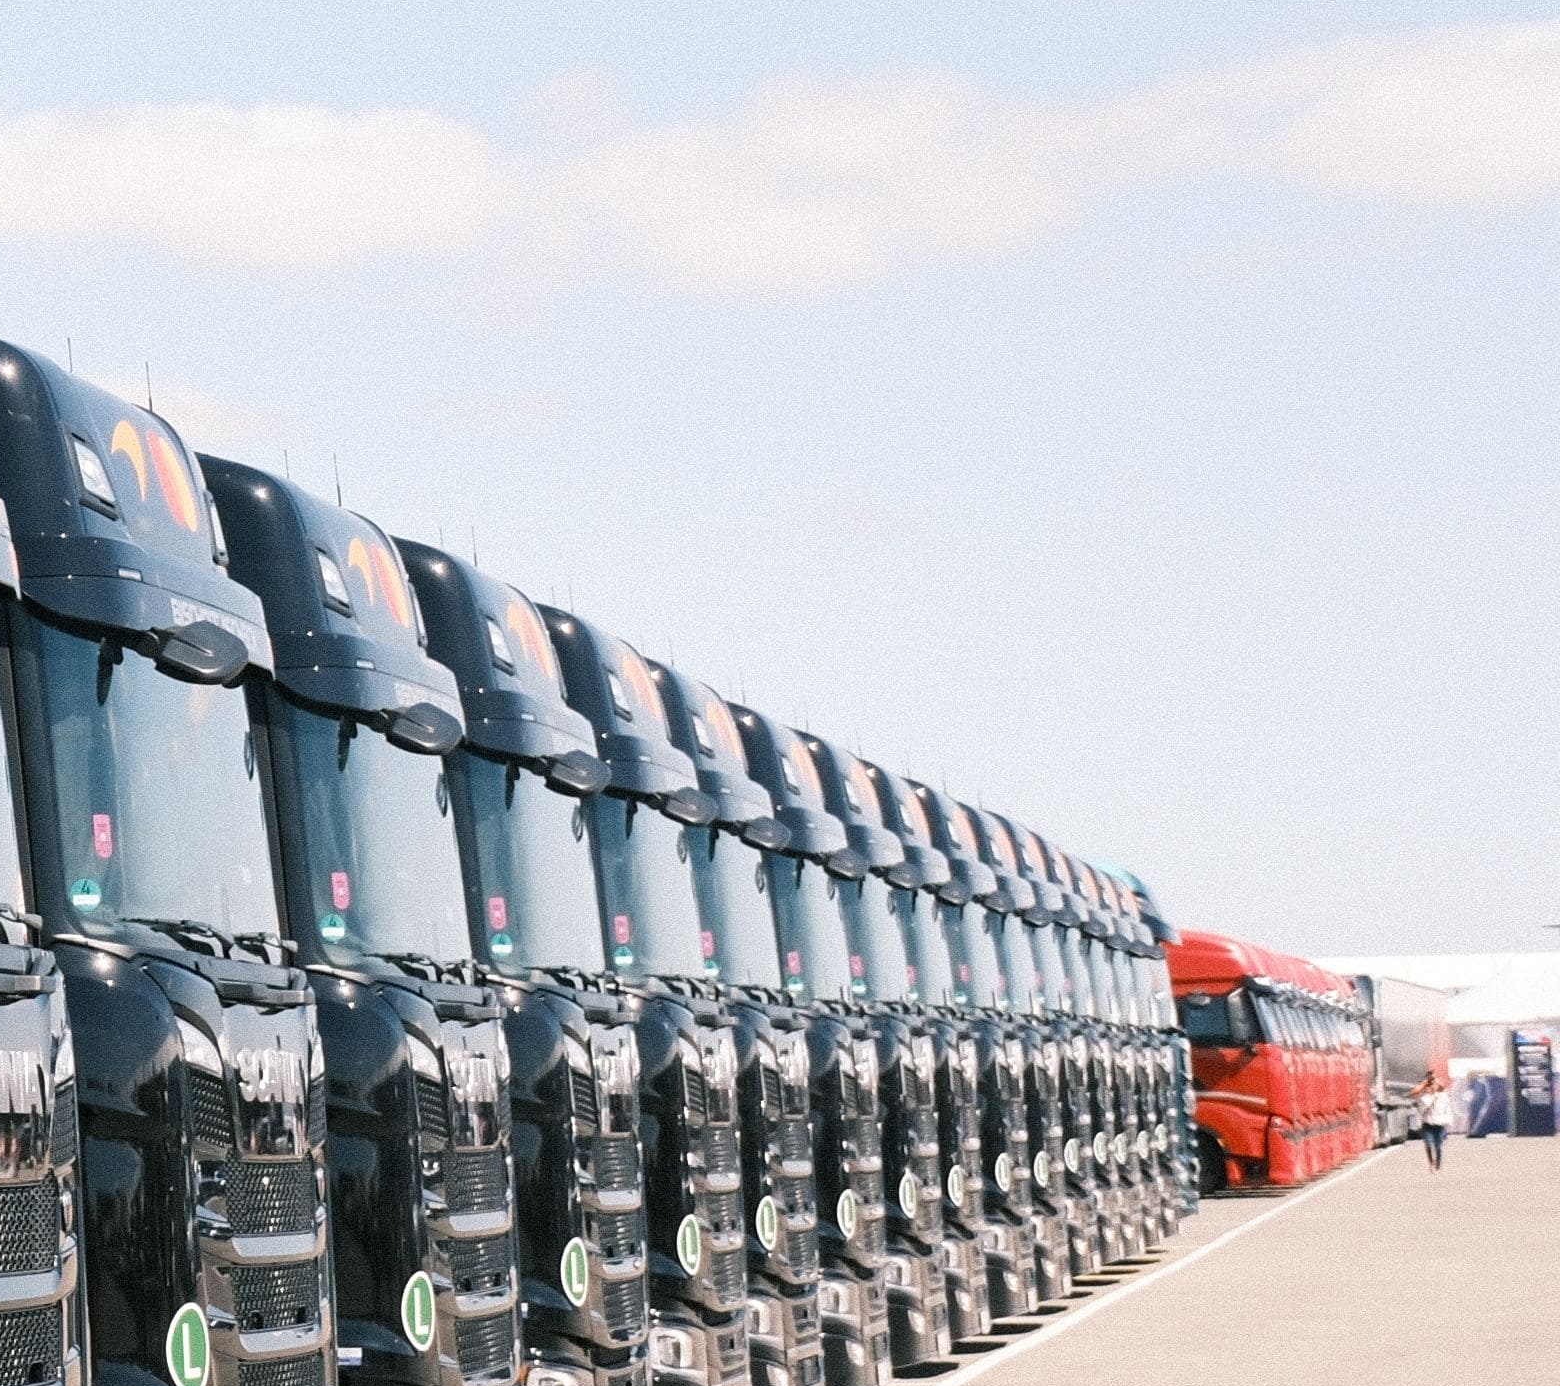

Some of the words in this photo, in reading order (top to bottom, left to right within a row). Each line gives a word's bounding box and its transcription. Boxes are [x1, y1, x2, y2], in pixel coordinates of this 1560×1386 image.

[570, 1251, 584, 1292] L
[413, 1287, 429, 1335] L
[182, 1322, 201, 1379] L
